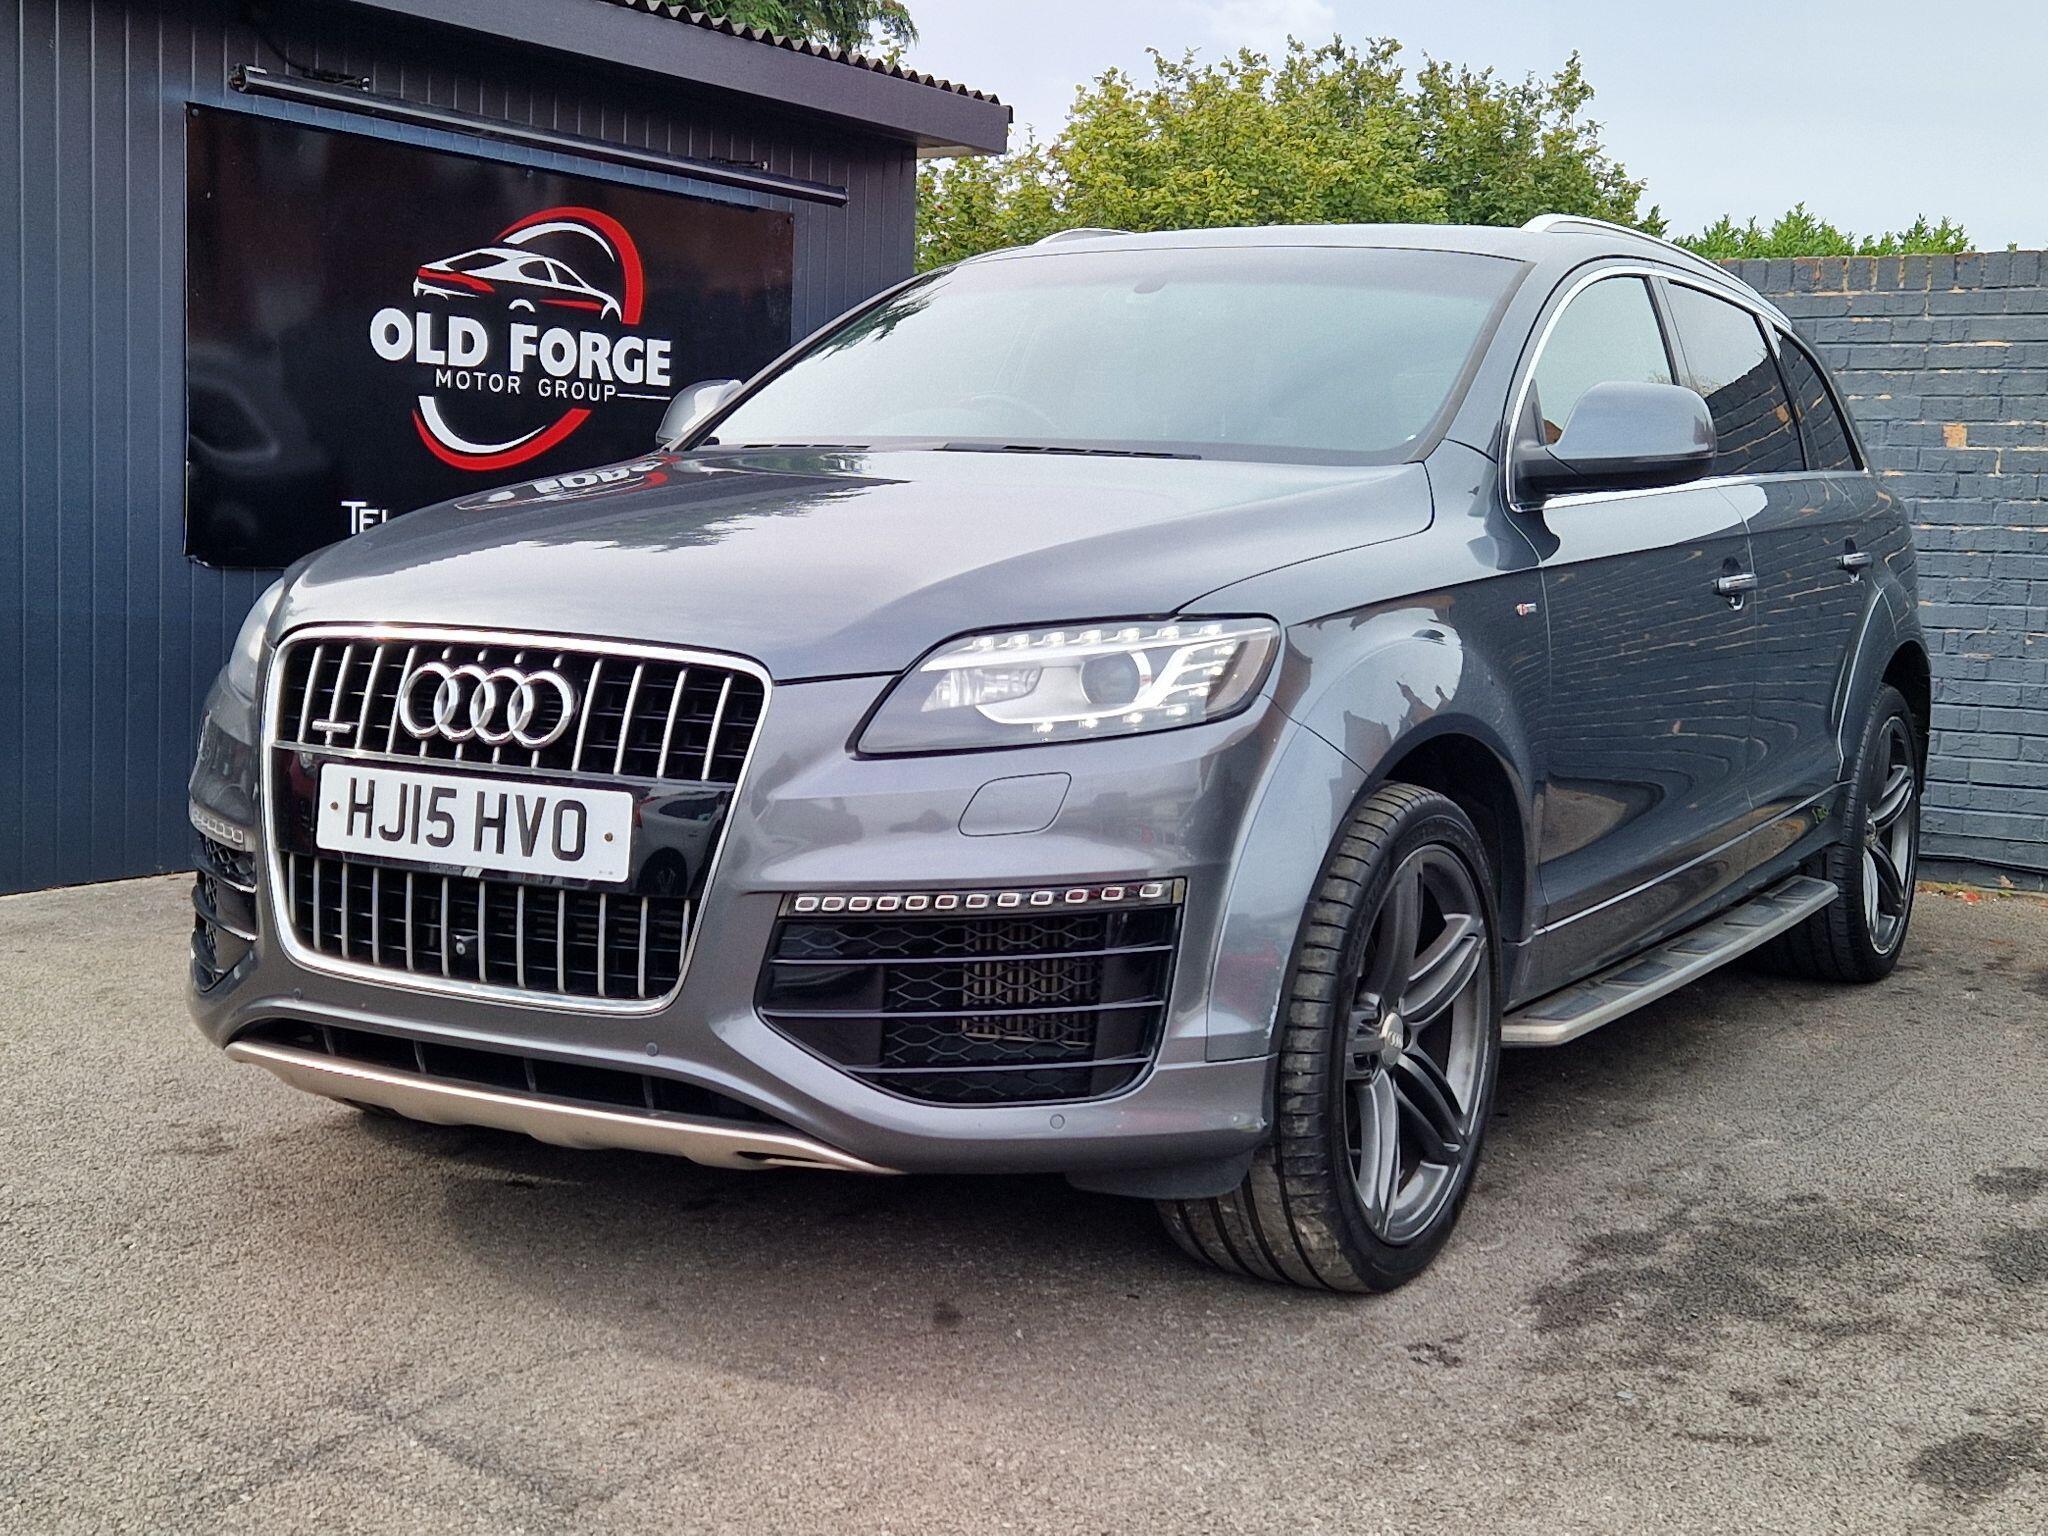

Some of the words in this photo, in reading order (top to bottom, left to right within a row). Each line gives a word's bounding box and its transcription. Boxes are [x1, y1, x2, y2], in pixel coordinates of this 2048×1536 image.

[369, 307, 489, 368] OLD
[509, 322, 671, 387] FORGE
[435, 368, 521, 395] MOTOR
[538, 378, 617, 403] GROUP
[346, 777, 458, 848] HJ15
[472, 791, 588, 862] HVO
